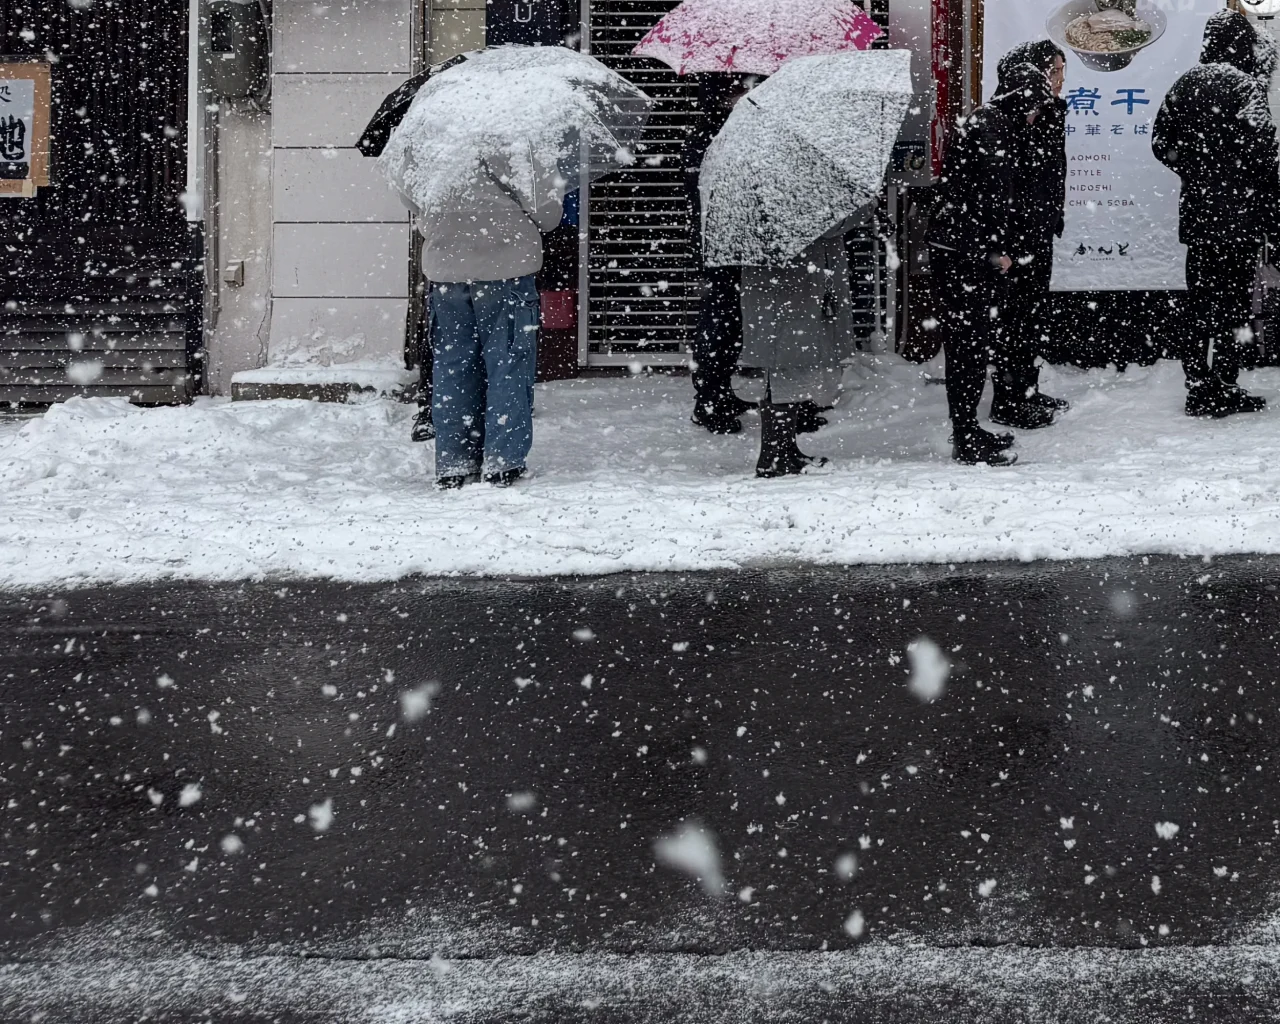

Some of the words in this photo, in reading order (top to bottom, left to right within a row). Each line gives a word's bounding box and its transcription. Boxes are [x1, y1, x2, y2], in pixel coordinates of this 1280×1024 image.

[1065, 87, 1150, 116] 煮干
[1064, 124, 1150, 136] 中華そば
